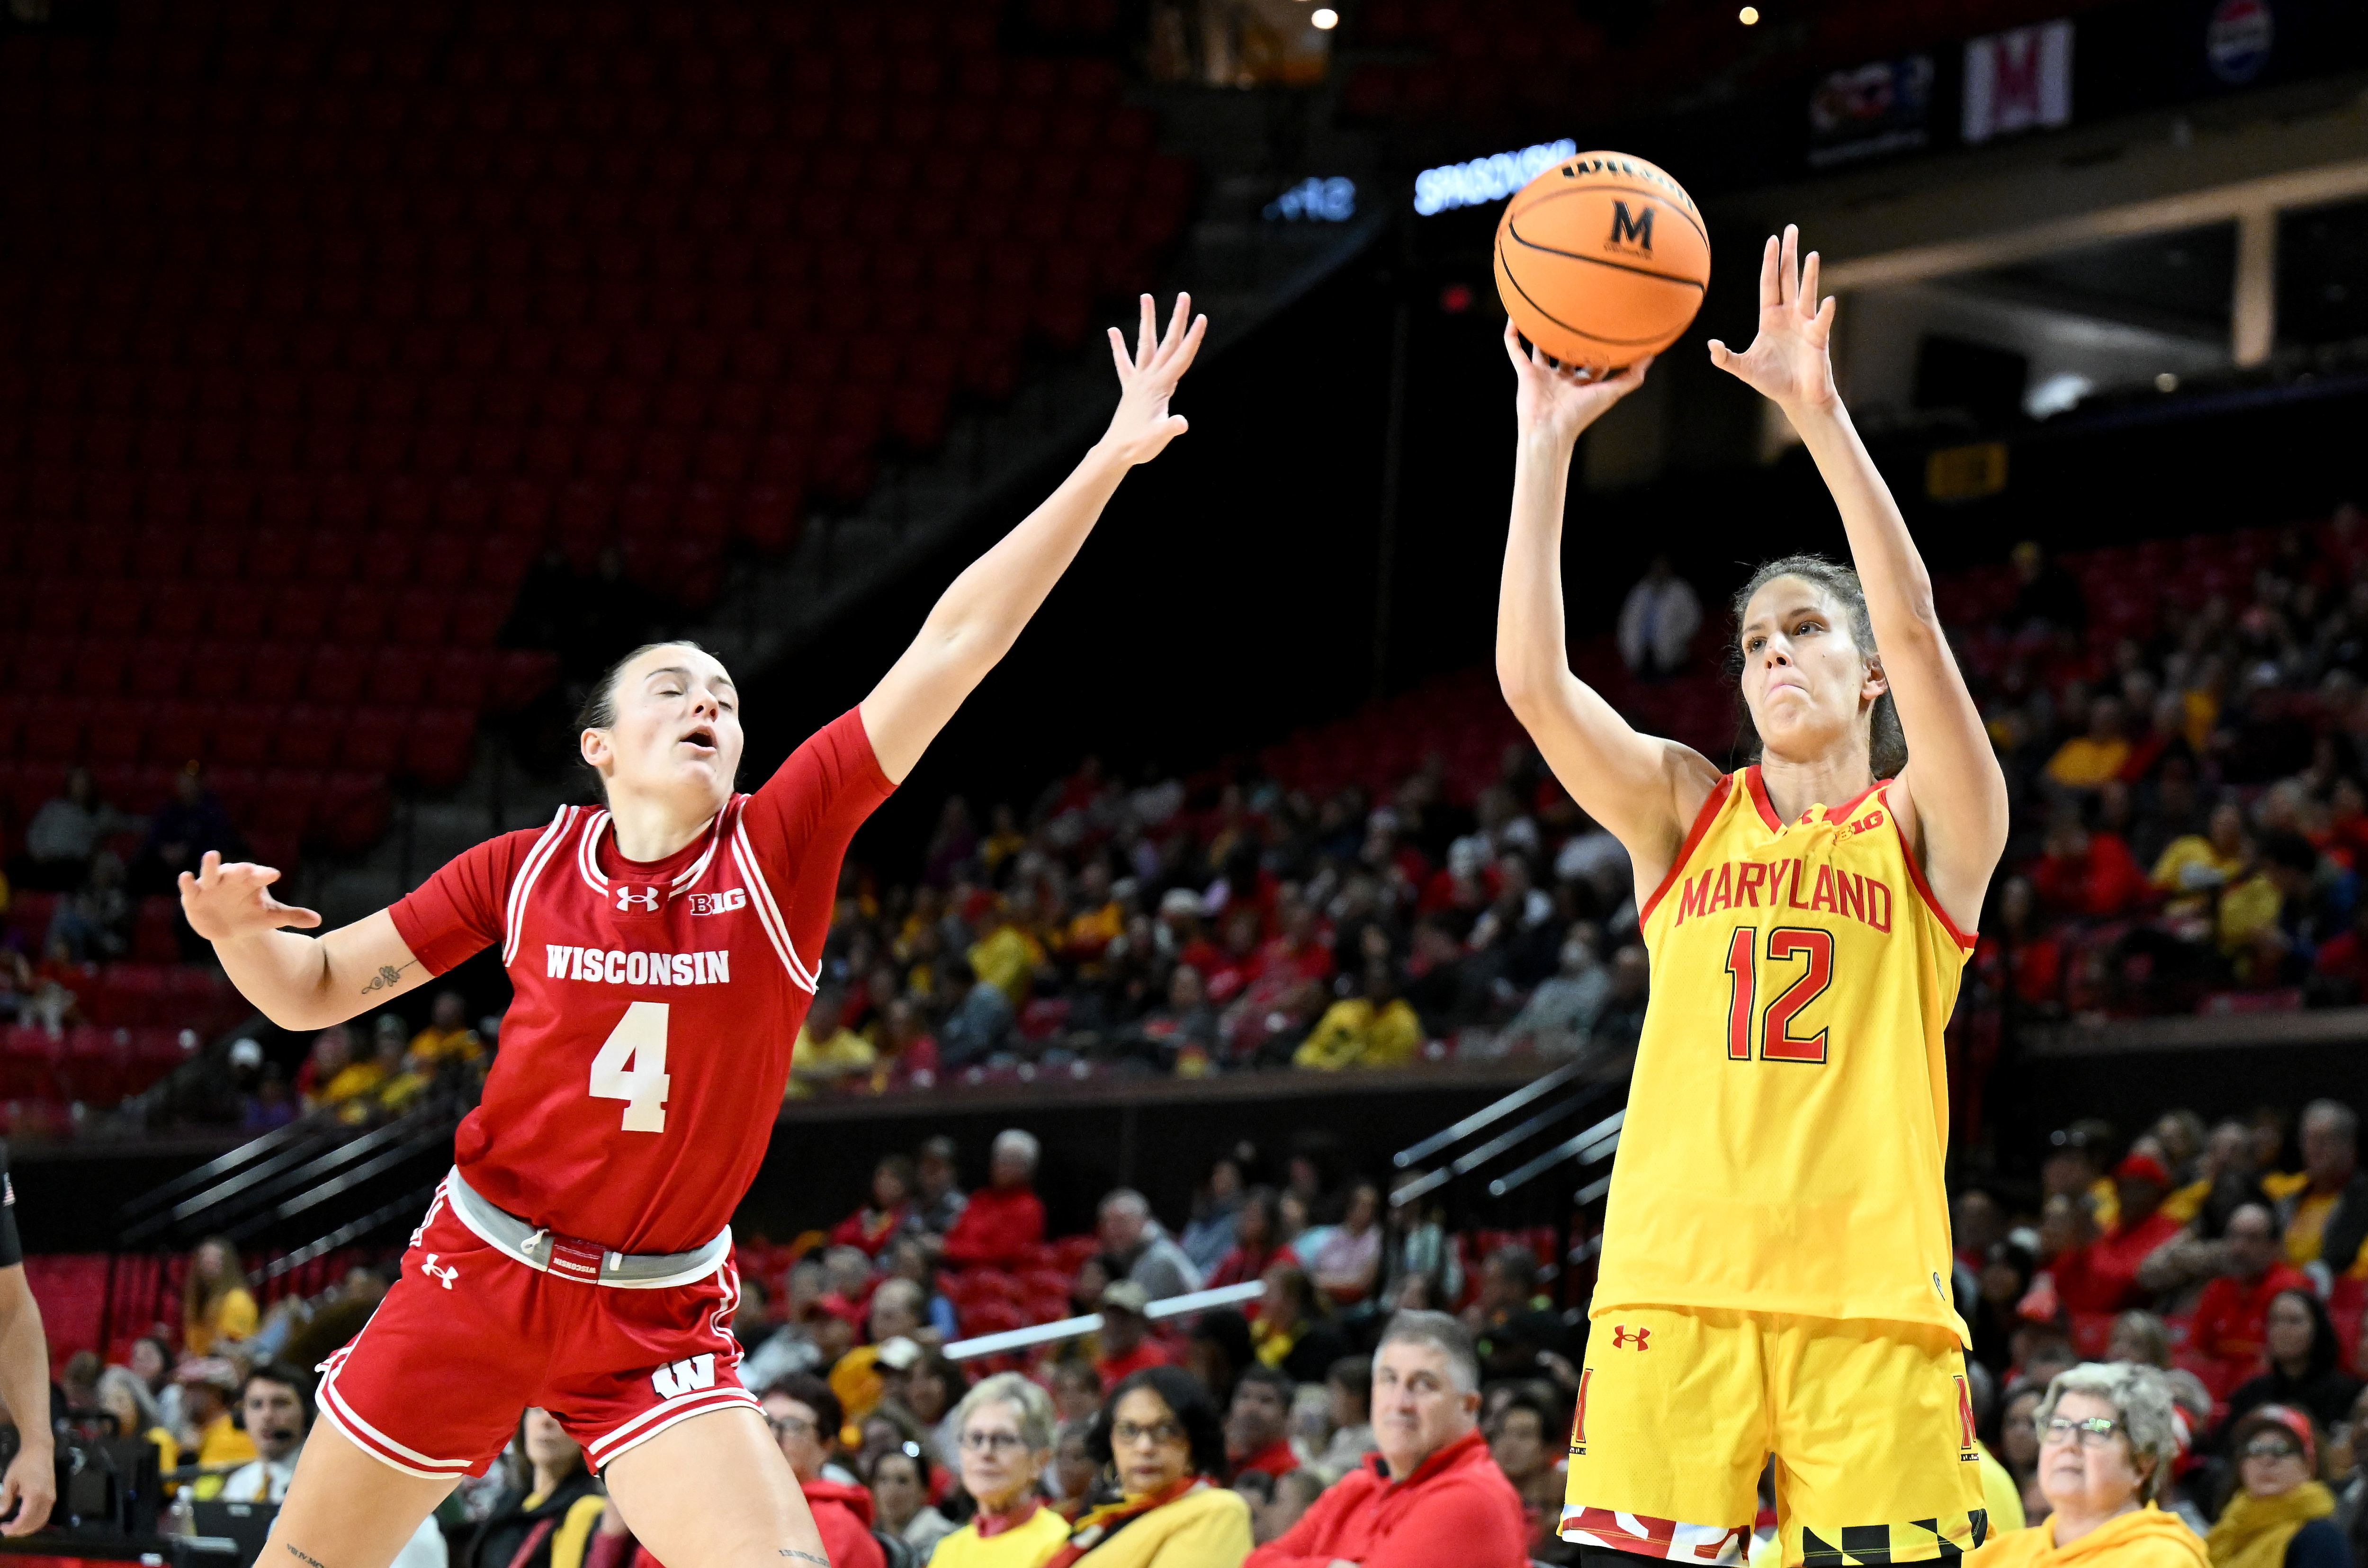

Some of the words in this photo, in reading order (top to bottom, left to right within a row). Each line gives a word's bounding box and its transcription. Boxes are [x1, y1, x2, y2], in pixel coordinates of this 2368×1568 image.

[1611, 199, 1654, 251] M
[1675, 858, 1891, 934] MARYLAND
[546, 944, 730, 986] WISCONSIN
[1725, 926, 1834, 1064] 12
[589, 1001, 670, 1133] 4
[651, 1353, 716, 1400] W
